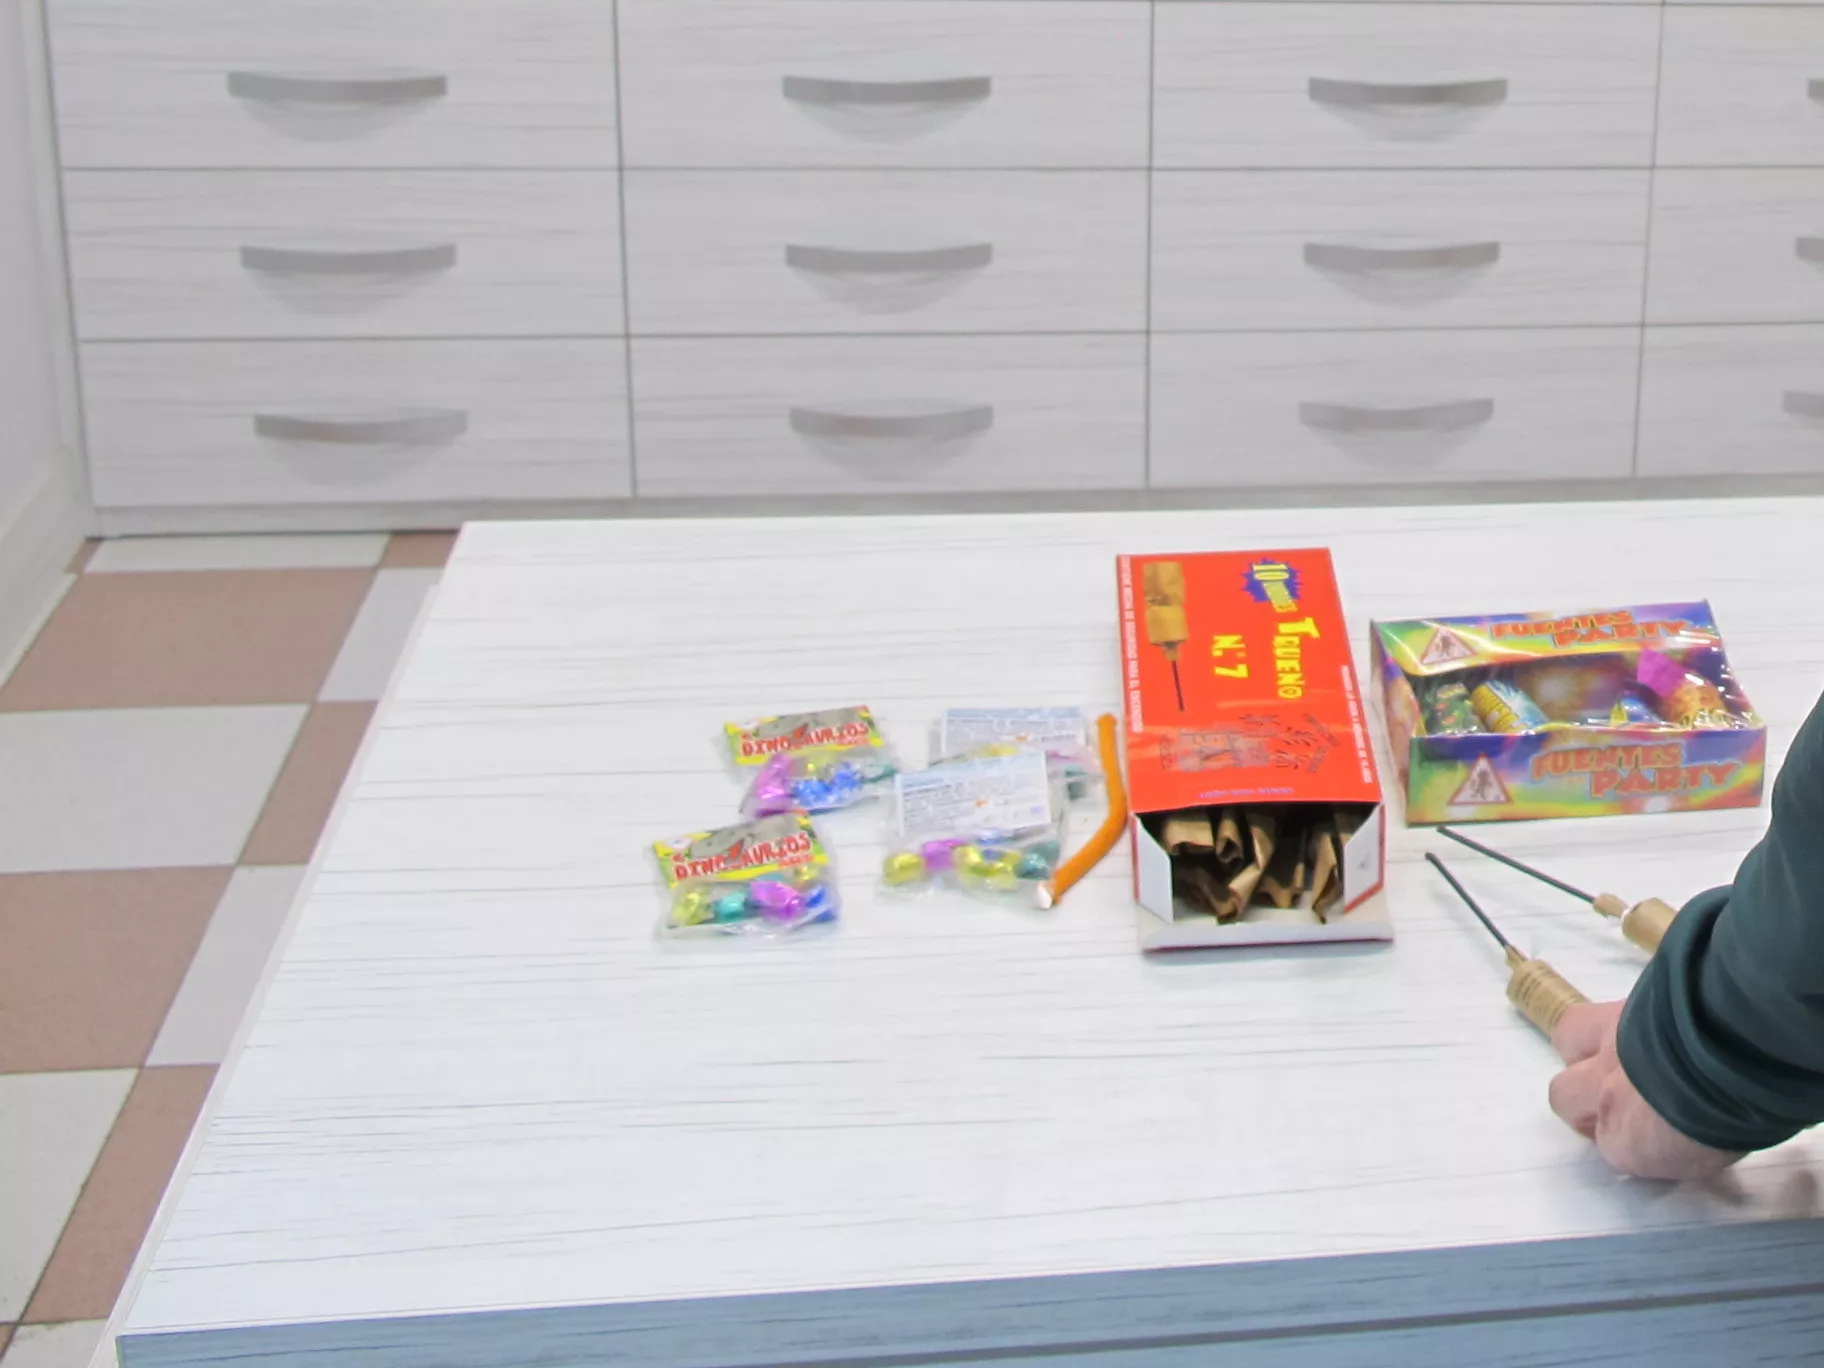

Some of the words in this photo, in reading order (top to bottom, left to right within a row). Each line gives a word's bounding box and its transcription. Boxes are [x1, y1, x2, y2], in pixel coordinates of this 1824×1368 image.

[1253, 563, 1290, 581] 10
[1491, 610, 1633, 639] FUENTES
[1552, 619, 1691, 648] PARTY
[1214, 663, 1249, 679] 7
[1273, 617, 1320, 700] TRUENO
[1530, 743, 1683, 781] FUENTES
[1590, 762, 1739, 798] PARTY
